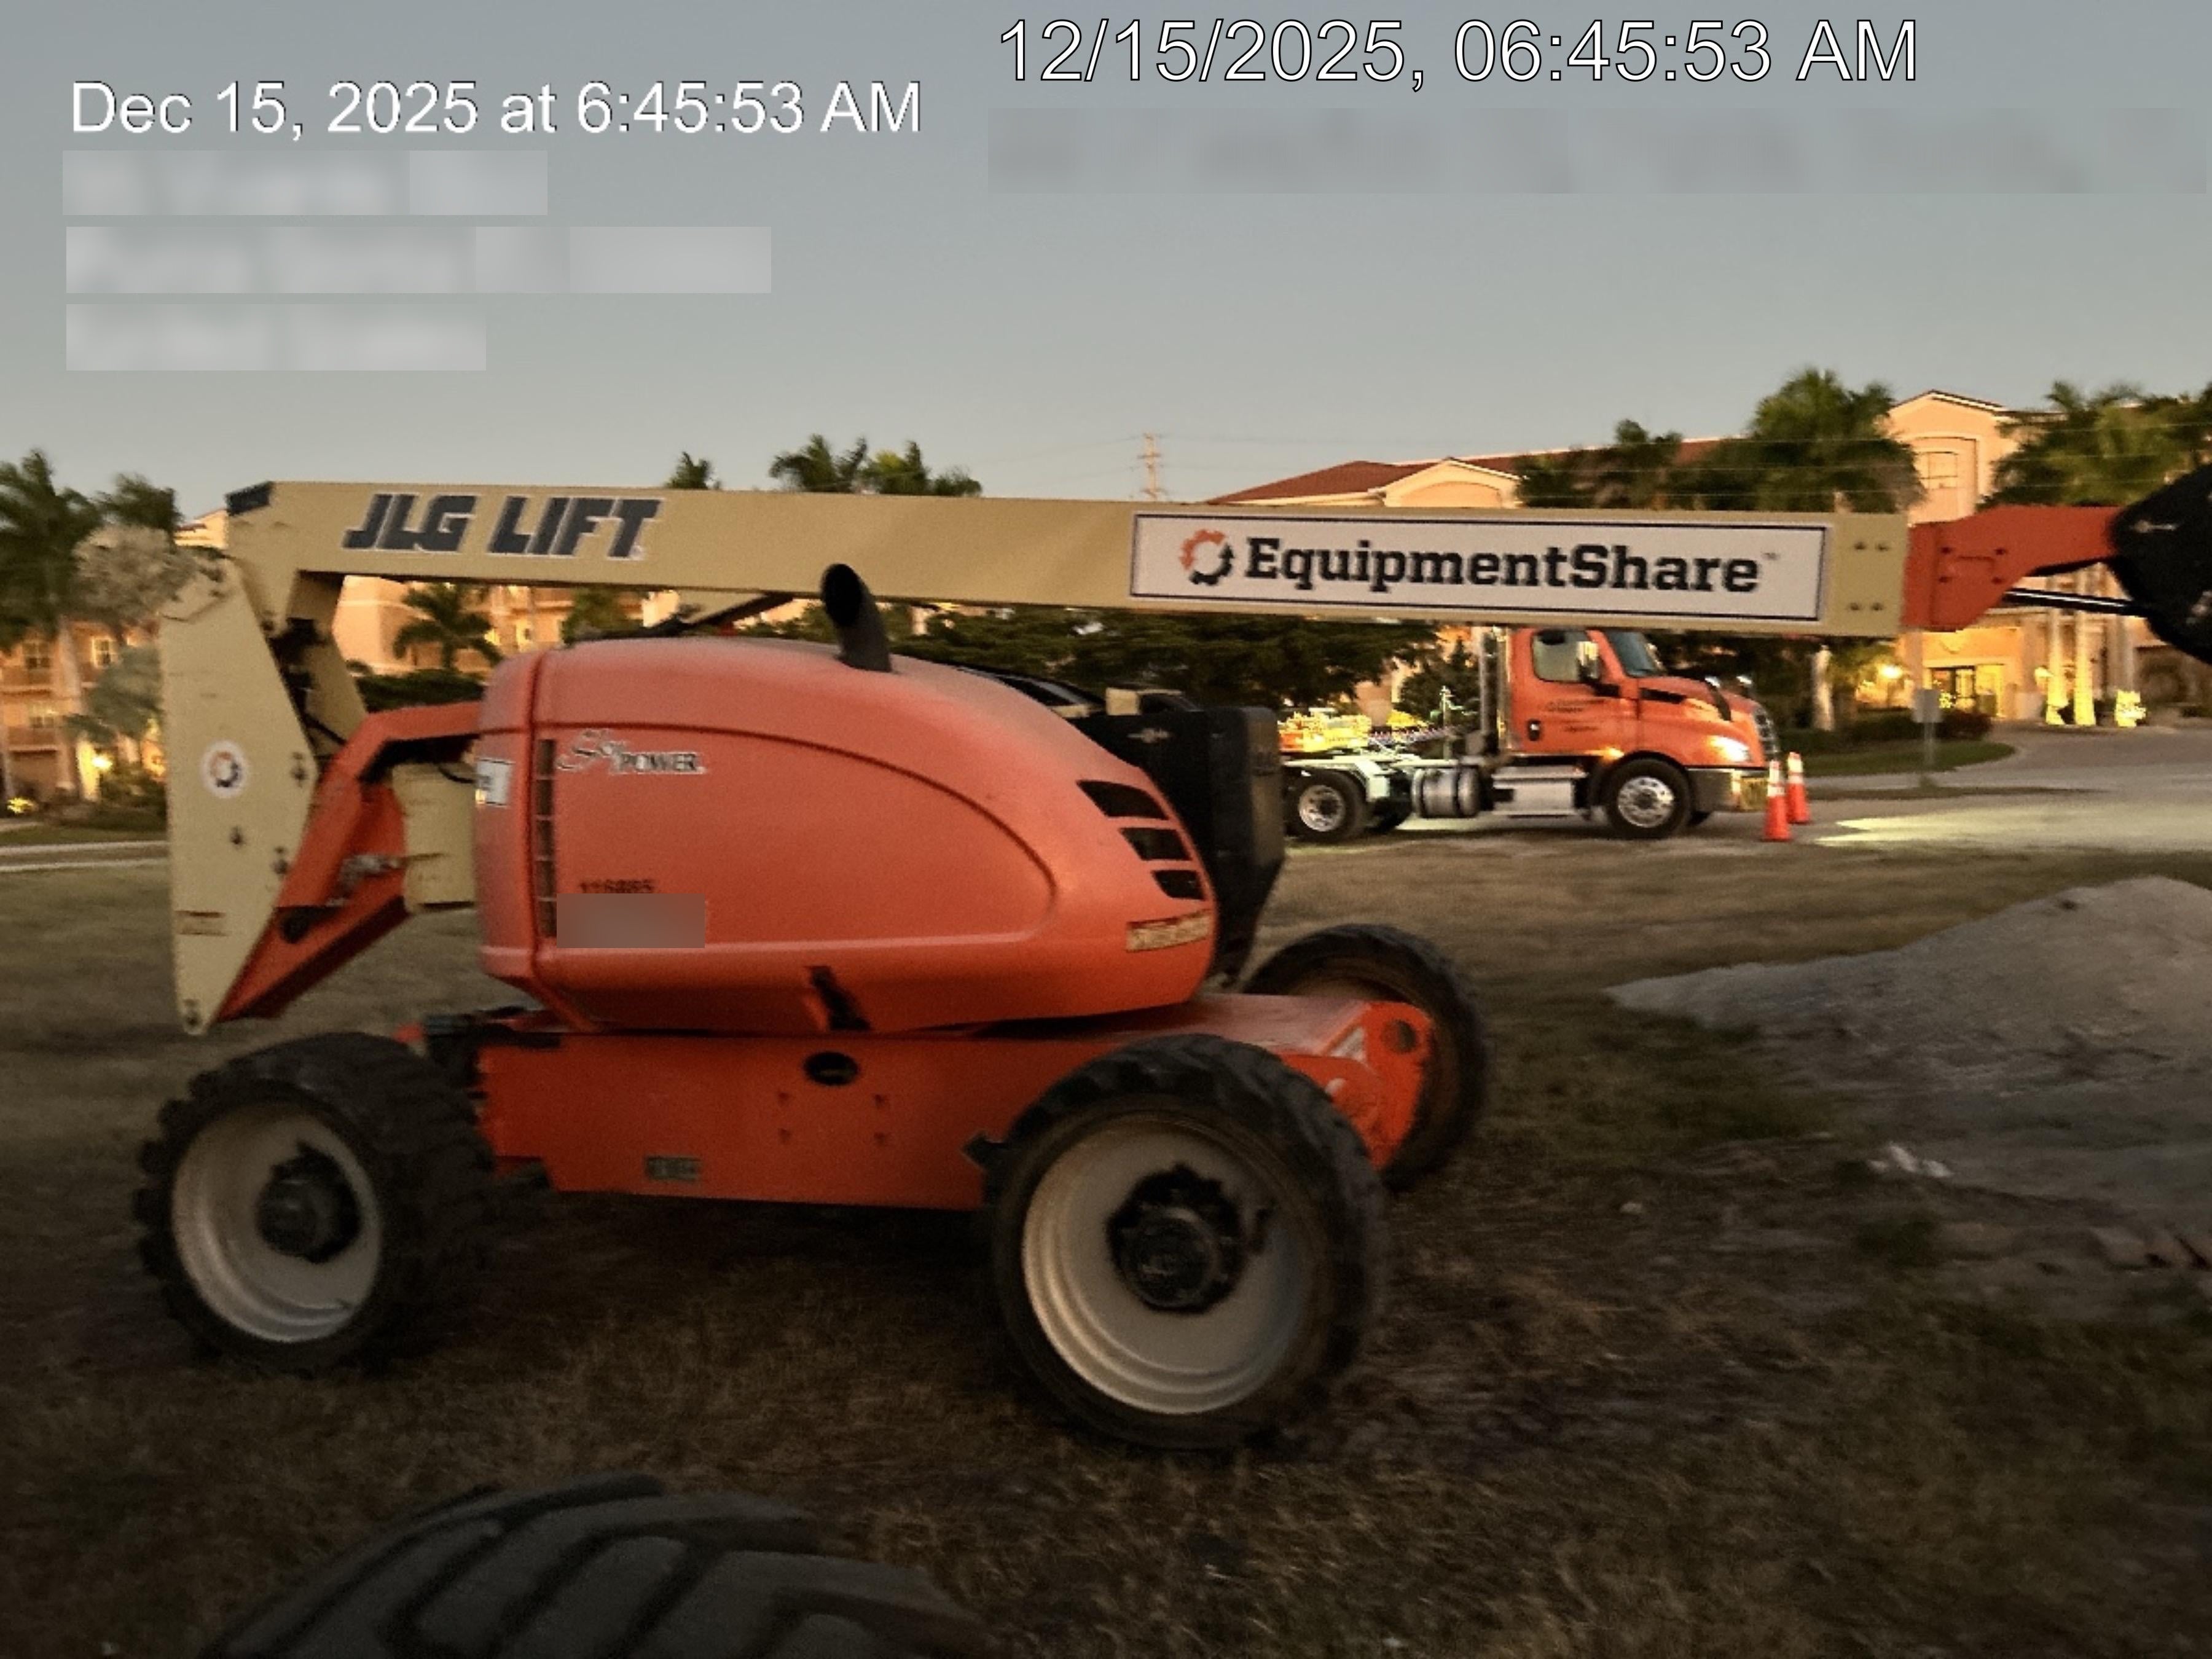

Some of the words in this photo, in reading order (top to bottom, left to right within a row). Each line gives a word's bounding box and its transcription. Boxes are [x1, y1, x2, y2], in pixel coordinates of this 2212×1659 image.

[342, 493, 477, 552] JLG
[488, 495, 662, 559] LIFT
[1245, 536, 1759, 593] EquipmentShare
